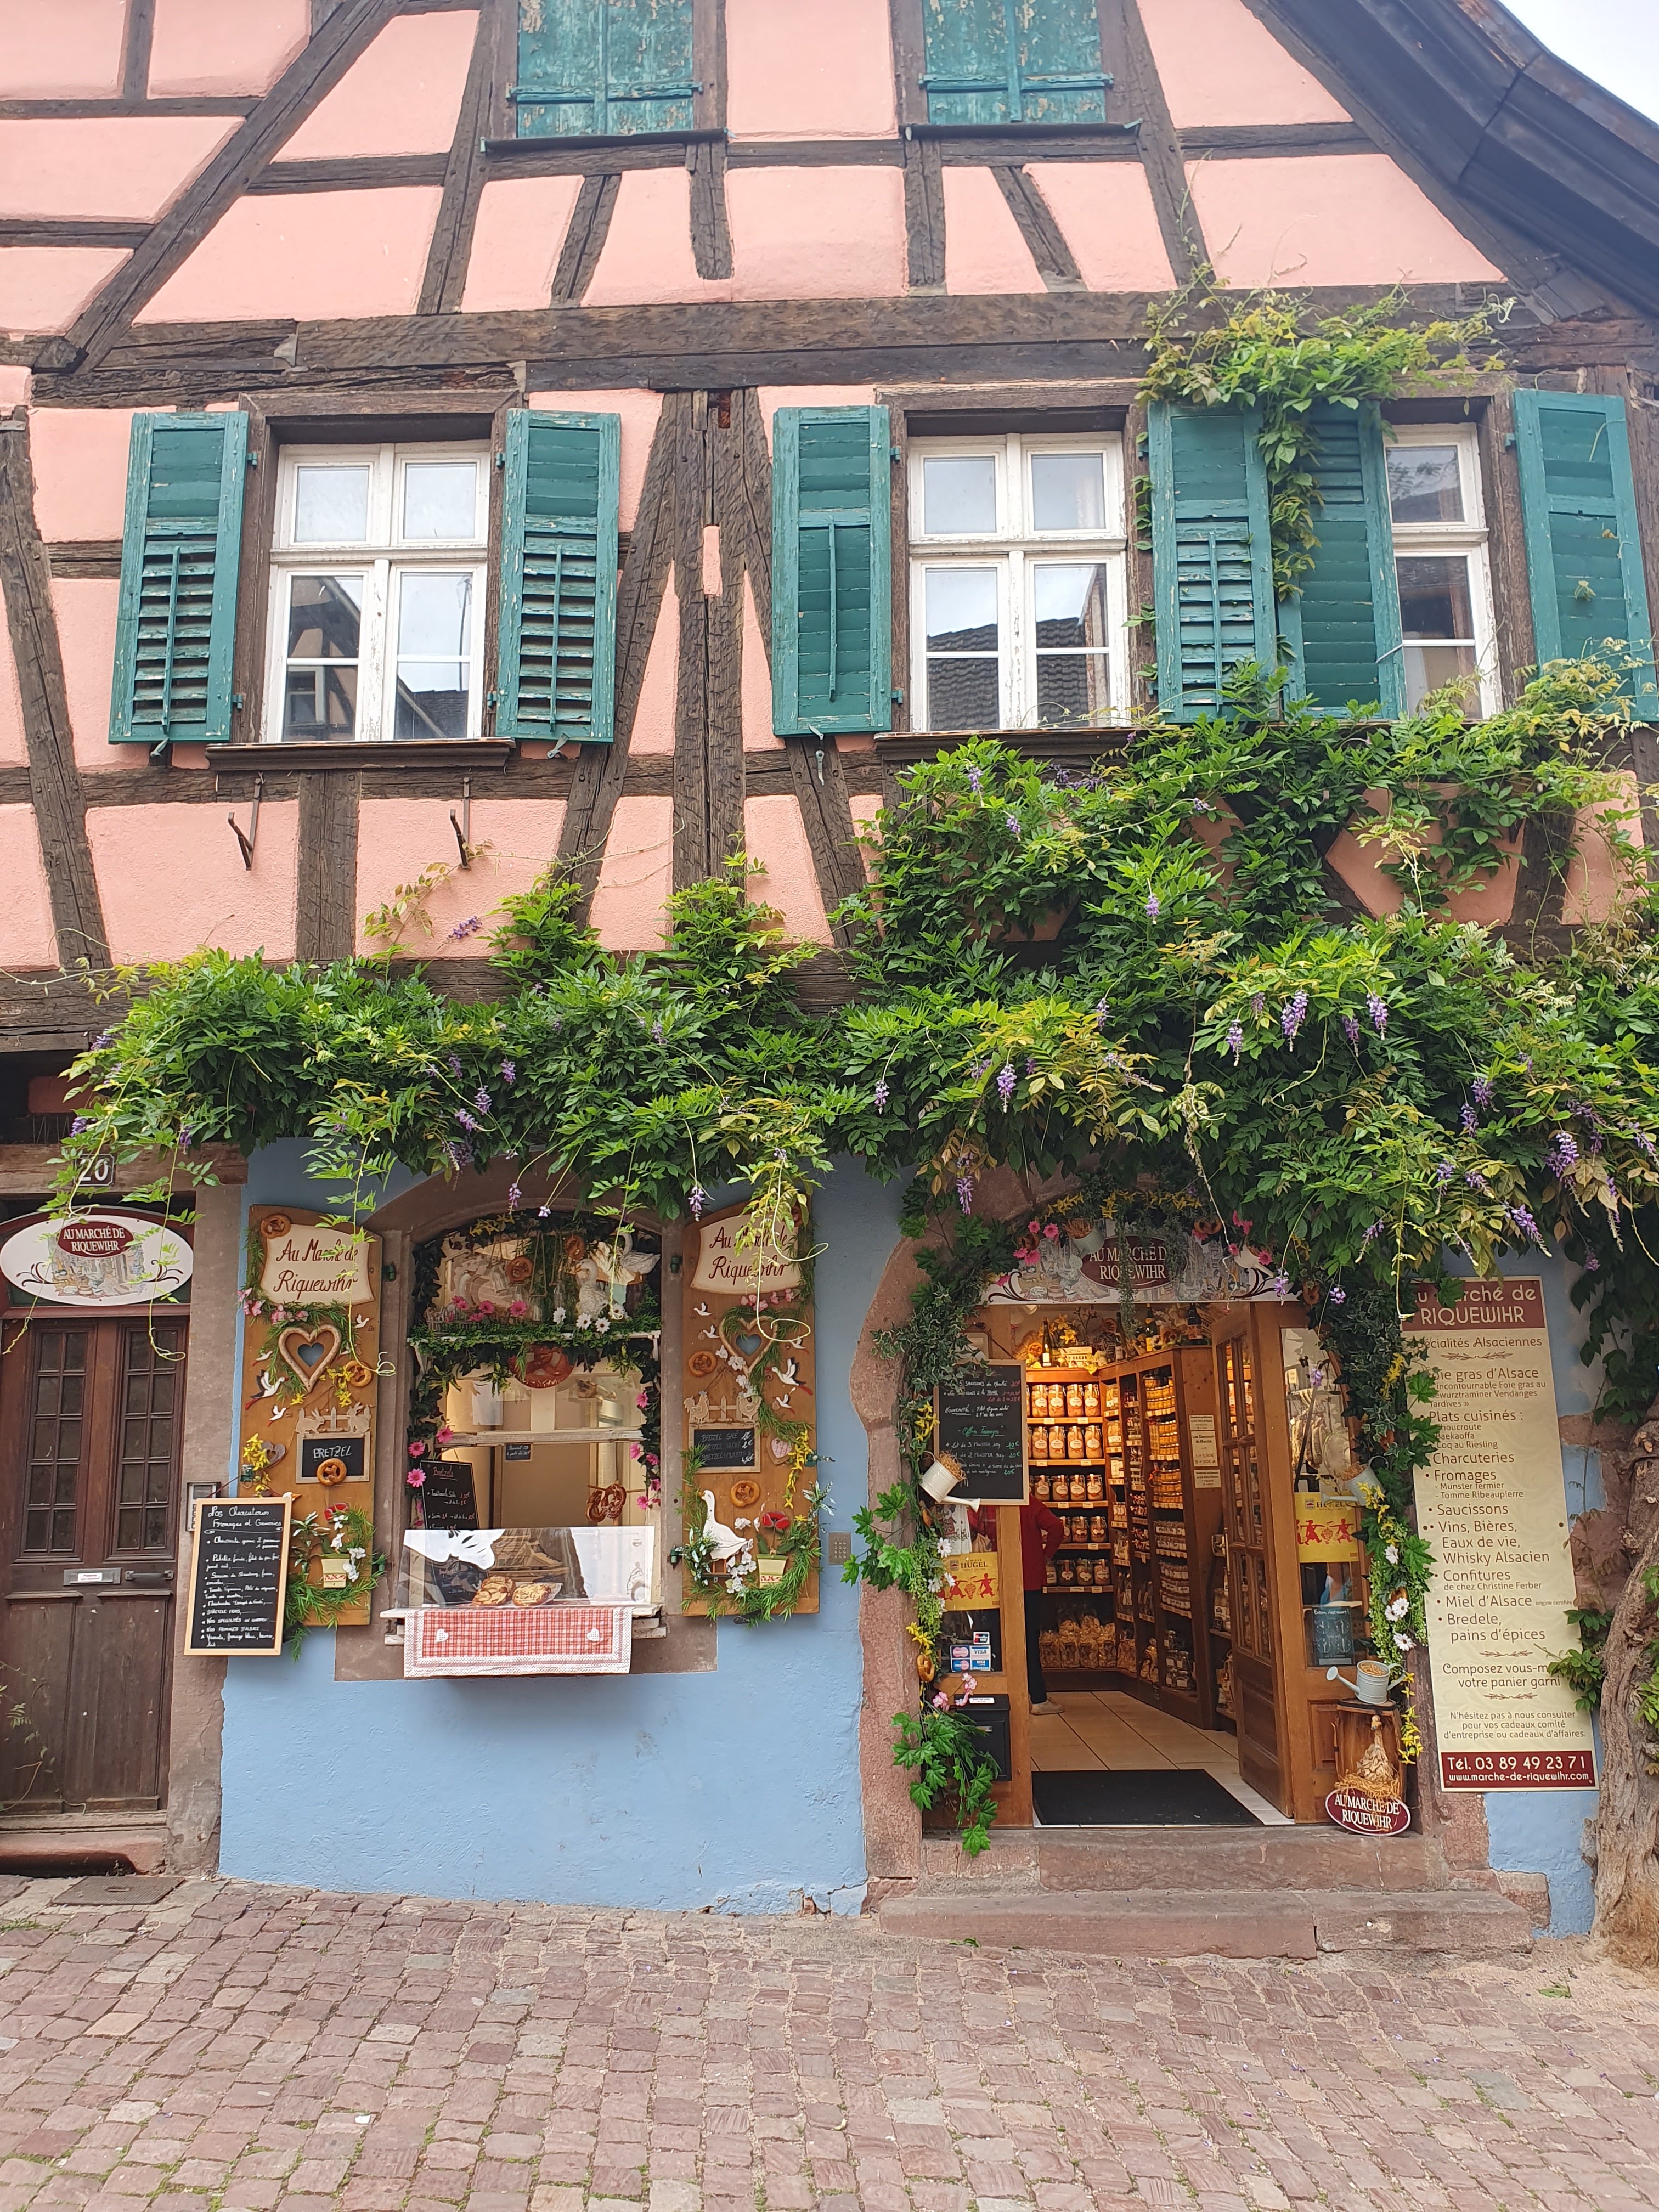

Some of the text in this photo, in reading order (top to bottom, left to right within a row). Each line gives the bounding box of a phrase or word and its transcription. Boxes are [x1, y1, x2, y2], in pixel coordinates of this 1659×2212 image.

[63, 1225, 125, 1239] AU MARCHÉ DE
[709, 1226, 731, 1249] Au
[71, 1240, 120, 1252] RIQUEWIHR
[276, 1239, 299, 1262] Au
[1099, 1265, 1167, 1281] RIQEWIHR
[273, 1269, 359, 1300] Riquewihr
[1511, 1284, 1537, 1301] de
[1420, 1306, 1525, 1326] RIQUEWIHR
[1472, 1336, 1543, 1348] Alsaciennes
[1455, 1370, 1482, 1383] gras
[1486, 1368, 1539, 1380] d'Alsace
[1499, 1380, 1516, 1389] Foie
[1517, 1381, 1534, 1391] gras
[1494, 1390, 1538, 1398] Vendanges
[1429, 1409, 1516, 1422] Plats cuisinés
[313, 1445, 352, 1459] BRETZEL
[1436, 1441, 1453, 1450] Coq
[1466, 1441, 1498, 1449] Riesling
[1432, 1451, 1515, 1464] Charcuteries
[1434, 1470, 1497, 1483] Fromages
[1440, 1481, 1504, 1490] Munster fermier
[1472, 1490, 1523, 1500] Ribeaupierre
[1437, 1503, 1509, 1516] Saucissons
[1438, 1520, 1518, 1534] Vins, Bières,
[1442, 1536, 1521, 1549] Eaux de vie,
[1443, 1550, 1550, 1566] Whisky Alsacien
[1443, 1569, 1511, 1582] Confitures
[1455, 1582, 1475, 1590] chez
[1477, 1581, 1514, 1590] Christine
[1516, 1581, 1542, 1590] Ferber
[1446, 1595, 1532, 1608] Miel d'Alsace
[1447, 1613, 1502, 1627] Bredele,
[1451, 1628, 1546, 1644] pains d'épices
[1442, 1663, 1503, 1677] Composez
[1458, 1676, 1561, 1690] votre panier garni
[1450, 1710, 1489, 1720] N'hésitez
[1491, 1712, 1505, 1722] pas
[1507, 1711, 1513, 1719] à
[1537, 1709, 1576, 1719] consulter
[1462, 1722, 1482, 1731] pour
[1500, 1720, 1535, 1729] cadeaux
[1537, 1719, 1566, 1728] comité
[1443, 1729, 1494, 1741] d'entreprise
[1509, 1730, 1544, 1739] cadeaux
[1546, 1729, 1587, 1737] d'affaires.
[1447, 1756, 1585, 1771] Tél. 03 89 49 23 71
[1449, 1771, 1589, 1782] www.marche-de-riquewihr.com
[1334, 1793, 1346, 1807] AU
[1386, 1801, 1400, 1815] DE
[1341, 1809, 1392, 1831] RIQUEWIHR
